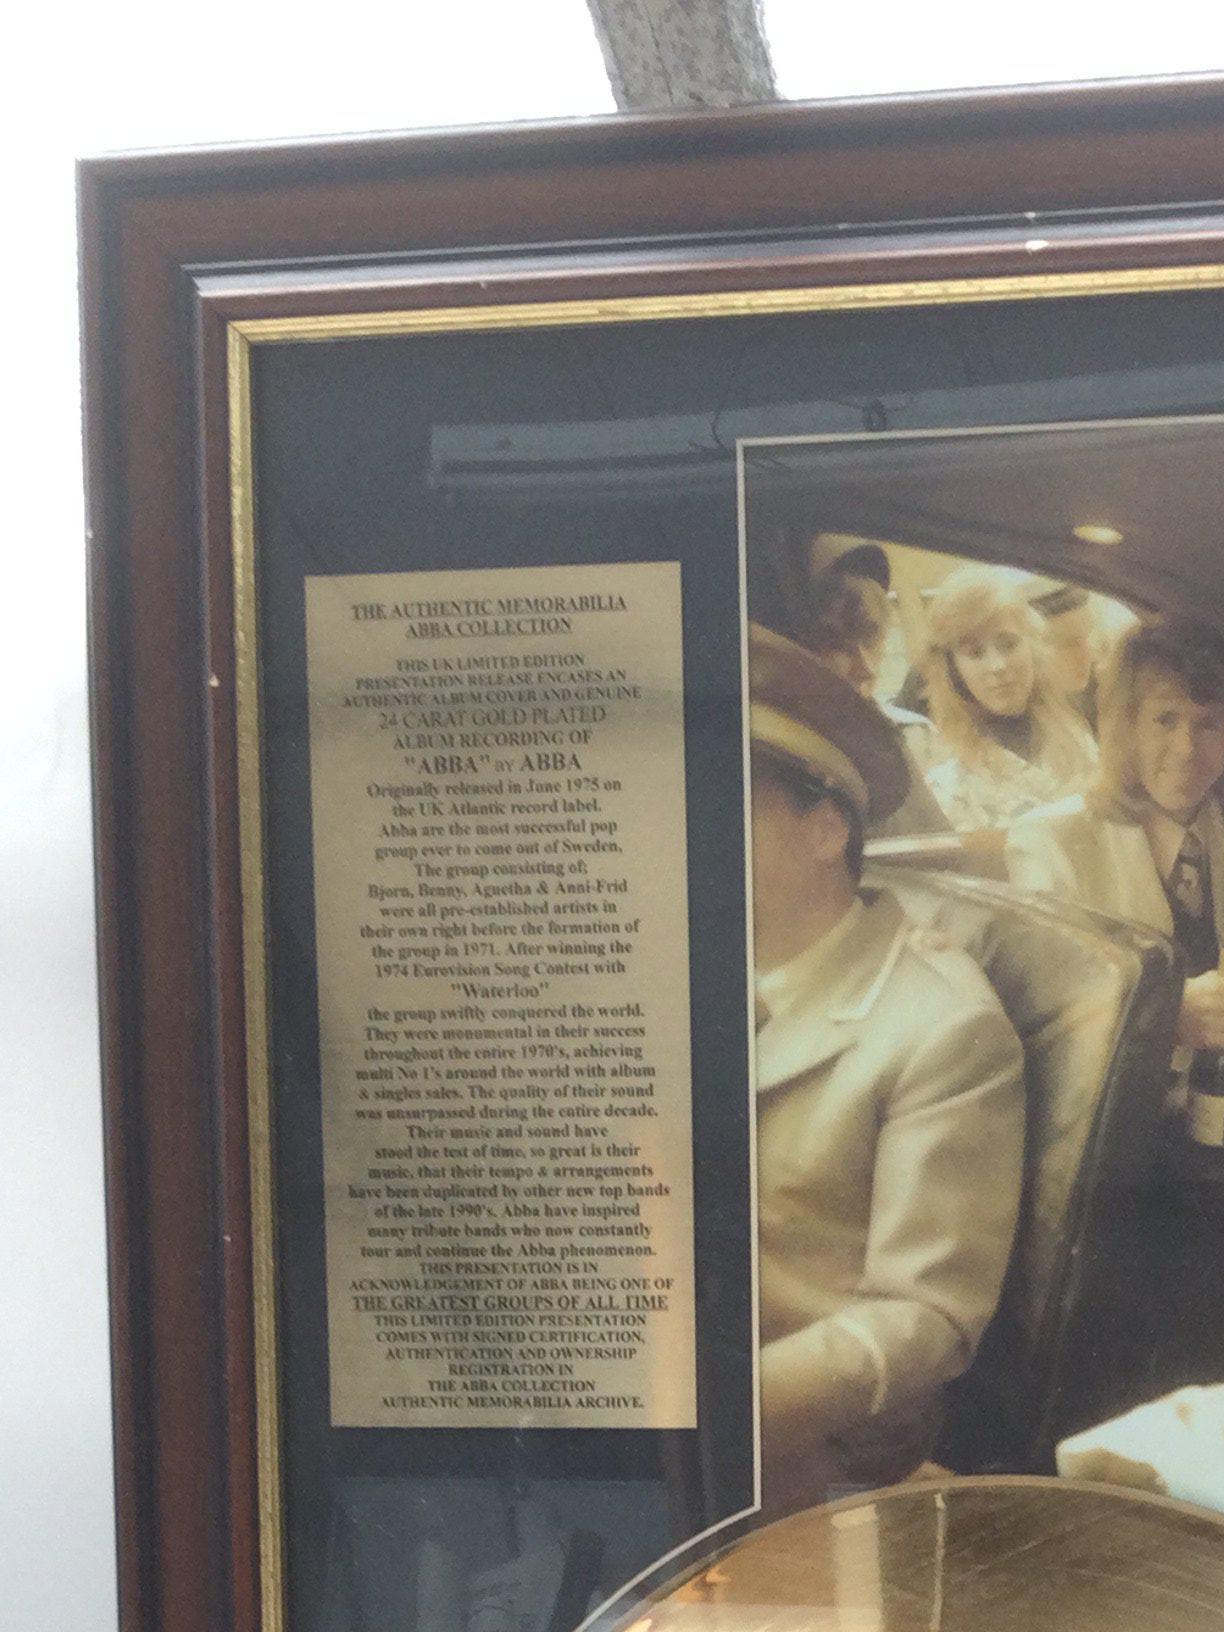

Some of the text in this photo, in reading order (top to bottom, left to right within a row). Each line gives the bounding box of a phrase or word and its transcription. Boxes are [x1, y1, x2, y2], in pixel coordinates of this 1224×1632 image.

[351, 593, 626, 620] THE AUTHENTIC MEMORABILIA
[405, 616, 571, 638] ABBA COLLECTION
[396, 652, 584, 672] THIS UK LIMITED EDITION
[402, 708, 467, 727] CARAT
[471, 707, 526, 725] GOLD
[532, 704, 607, 723] PLATED
[393, 728, 592, 749] ALBUM RECORDING OF
[404, 753, 490, 775] "ABBA"
[520, 751, 582, 771] ABBA
[365, 780, 438, 801] Originally
[445, 779, 503, 796] released
[508, 783, 521, 794] in
[525, 777, 561, 793] June
[603, 779, 622, 791] on
[392, 803, 414, 817] the
[419, 801, 443, 816] UK
[451, 800, 505, 816] Atlantic
[510, 798, 558, 814] record
[378, 818, 617, 837] Abba are the most successful pop
[374, 846, 417, 862] group
[421, 846, 452, 857] ever
[456, 844, 470, 855] to
[475, 844, 511, 855] come
[516, 842, 539, 854] out
[543, 839, 558, 853] of
[414, 862, 441, 877] The
[446, 864, 489, 879] group
[492, 860, 565, 878] consisting
[536, 880, 548, 894] &
[371, 943, 393, 958] the
[398, 946, 440, 961] group
[444, 944, 458, 956] in
[508, 941, 543, 955] After
[546, 941, 605, 958] winning
[609, 939, 632, 953] the
[375, 963, 408, 978] 1974
[494, 961, 530, 978] Song
[533, 961, 589, 975] Contest
[593, 959, 626, 974] with
[450, 981, 549, 999] "Waterloo"
[367, 1006, 389, 1021] the
[394, 1009, 436, 1024] group
[491, 1003, 567, 1022] conquered
[571, 1002, 594, 1017] the
[406, 1123, 608, 1139] Their music and sound have
[360, 1245, 391, 1257] tour
[395, 1243, 421, 1257] and
[425, 1242, 486, 1257] continue
[490, 1243, 512, 1256] the
[520, 1242, 555, 1256] Abba
[420, 1261, 597, 1274] THIS PRESENTATION IS IN
[507, 1278, 525, 1289] OF
[532, 1278, 568, 1290] ABBA
[572, 1278, 616, 1290] BEING
[620, 1277, 649, 1289] ONE
[653, 1277, 674, 1289] OF
[352, 1294, 668, 1310] THE GREATEST GROUPS OF ALL TIME
[374, 1314, 646, 1326] THIS LIMITED EDITION PRESENTATION
[375, 1330, 426, 1342] COMES
[430, 1331, 468, 1342] WITH
[473, 1331, 526, 1342] SIGNED
[519, 1347, 546, 1359] AND
[549, 1347, 637, 1359] OWNERSHIP
[448, 1363, 573, 1375] REGISTRATION IN
[428, 1379, 595, 1392] THE ABBA COLLECTION
[382, 1395, 459, 1408] AUTHENTIC
[467, 1395, 571, 1408] MEMORABILIA
